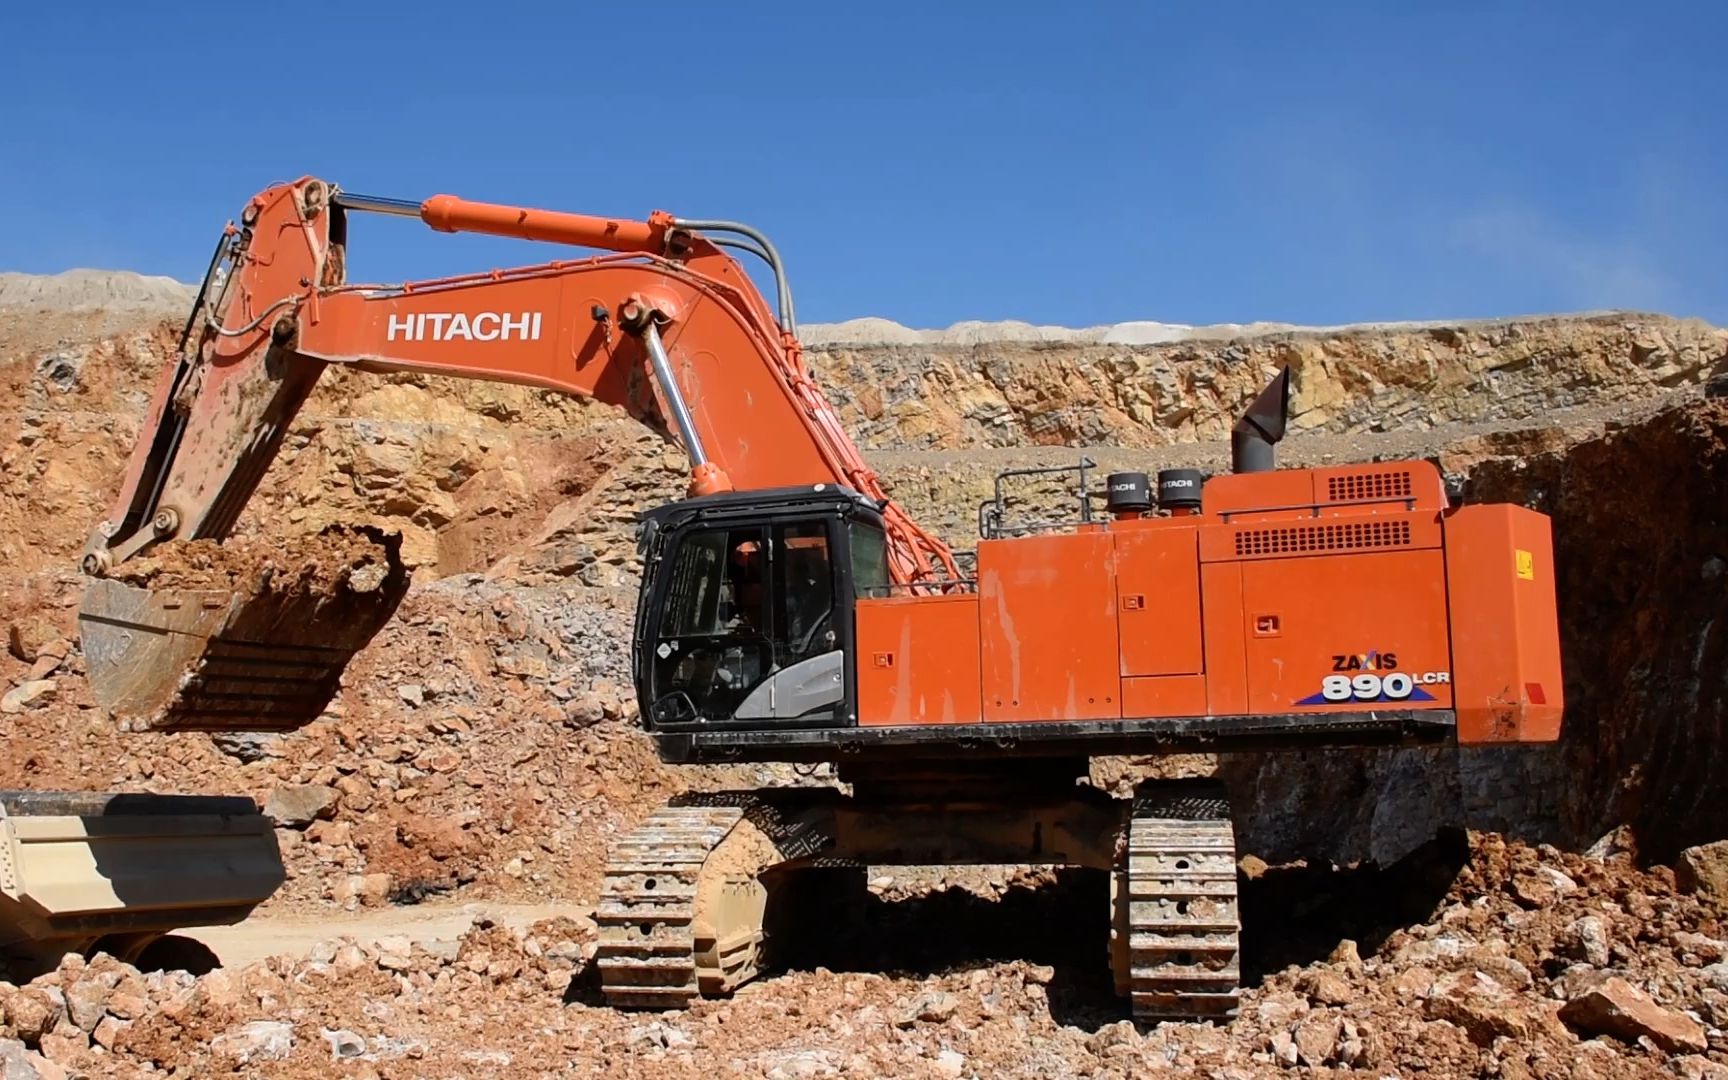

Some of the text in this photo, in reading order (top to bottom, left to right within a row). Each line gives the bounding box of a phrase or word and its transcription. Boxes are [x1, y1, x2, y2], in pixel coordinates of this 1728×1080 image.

[387, 312, 542, 341] HITACHI
[1332, 650, 1398, 671] ZAXIS
[1322, 672, 1451, 701] 890 LCR
